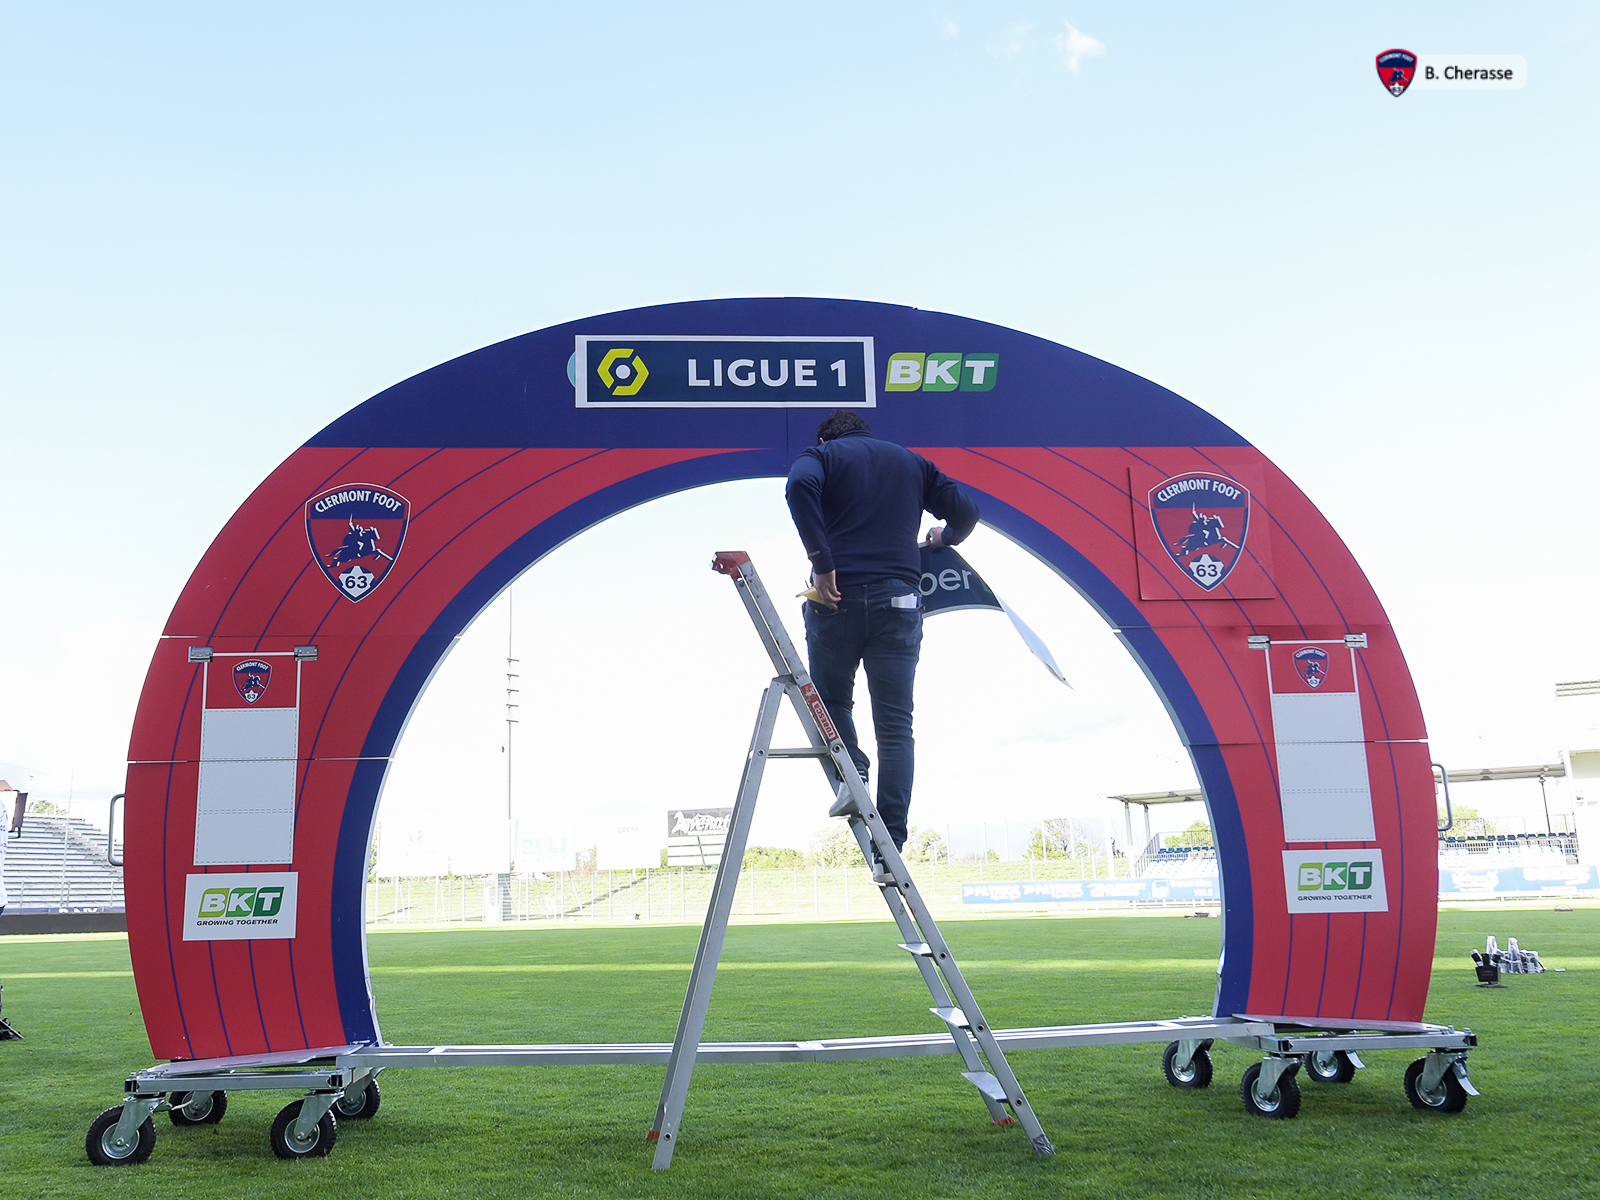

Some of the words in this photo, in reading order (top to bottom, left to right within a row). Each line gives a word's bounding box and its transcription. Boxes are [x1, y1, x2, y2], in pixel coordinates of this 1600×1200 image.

[688, 358, 817, 388] LIGUE
[830, 358, 847, 387] 1
[887, 356, 997, 388] BKT
[315, 490, 371, 513] CLERMONT
[372, 492, 402, 512] FOOT
[1157, 479, 1210, 502] CLERMONT
[1212, 481, 1241, 500] FOOT
[345, 576, 368, 589] 63
[1196, 564, 1218, 578] 63
[1299, 864, 1371, 888] BKT
[200, 890, 282, 915] BKT
